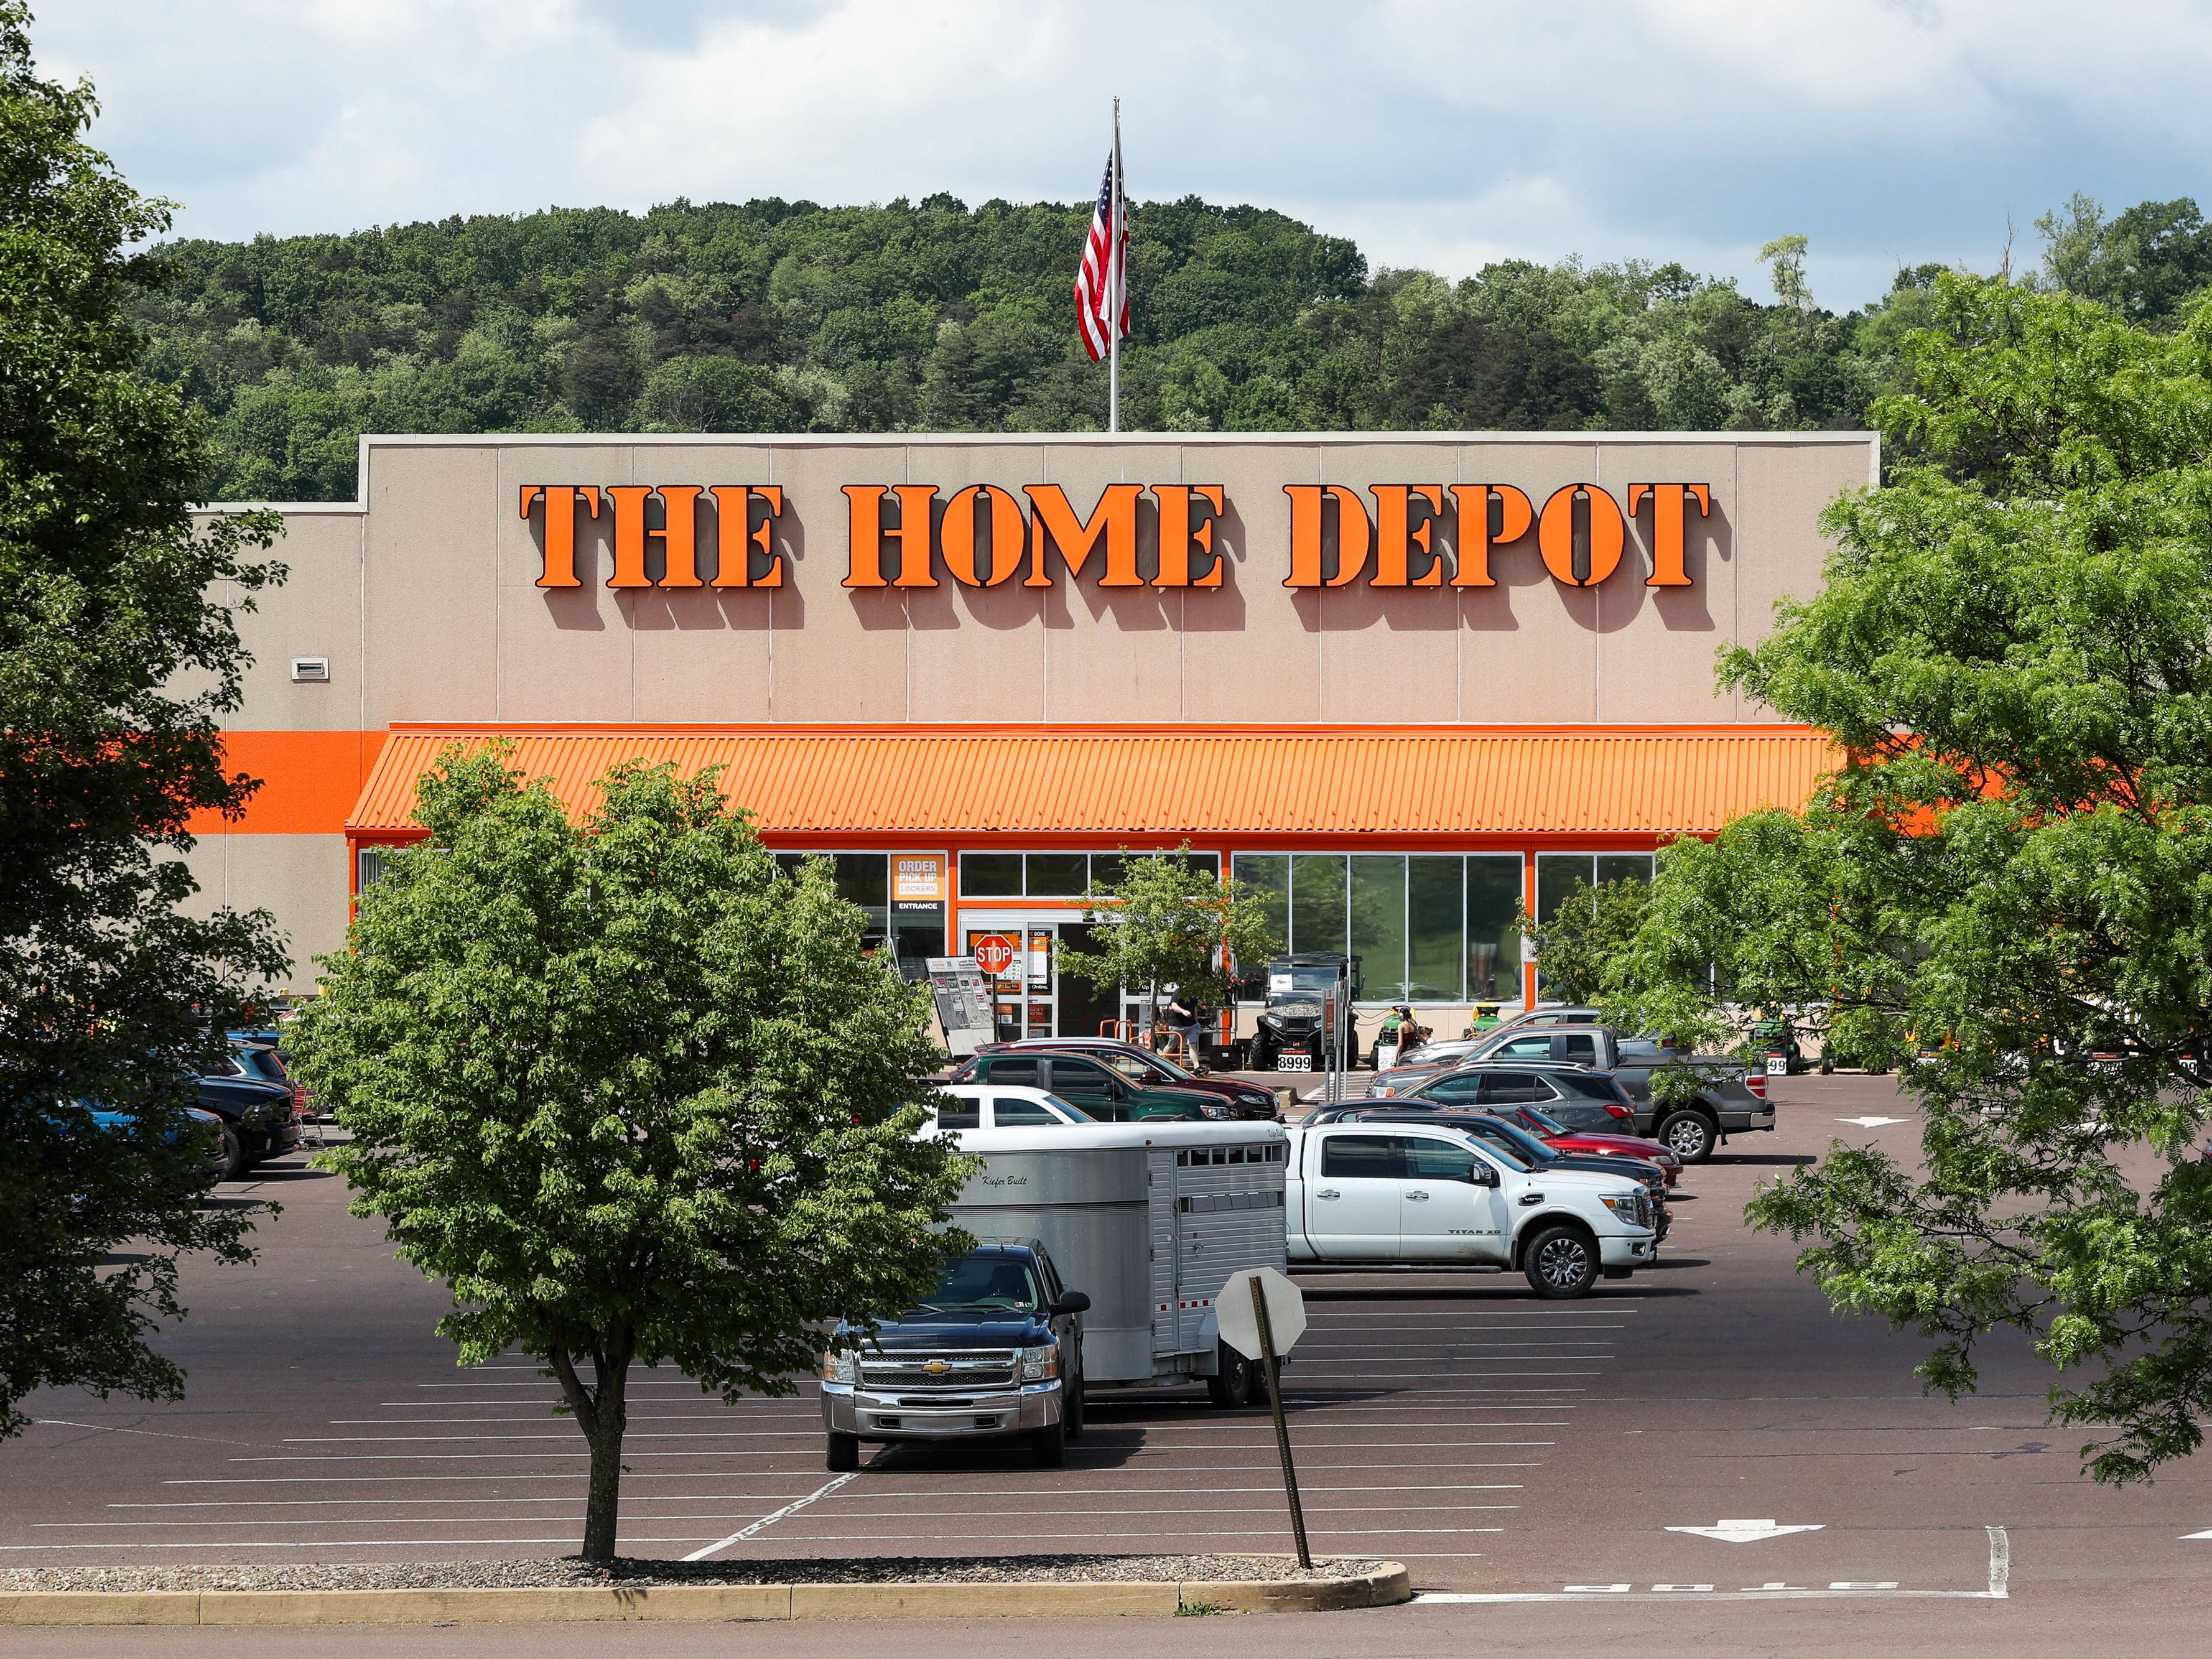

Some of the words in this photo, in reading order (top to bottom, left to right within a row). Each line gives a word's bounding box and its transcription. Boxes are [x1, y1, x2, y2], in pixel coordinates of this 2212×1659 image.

[519, 485, 783, 588] THE
[840, 483, 1224, 588] HOME
[1281, 483, 1710, 588] DEPOT
[898, 860, 937, 872] ORDER
[899, 872, 921, 882] PICK
[924, 872, 937, 882] UP
[977, 947, 1011, 962] STOP
[1279, 1056, 1311, 1069] 8999
[982, 1176, 1005, 1187] Kiefer
[1007, 1175, 1027, 1185] Built
